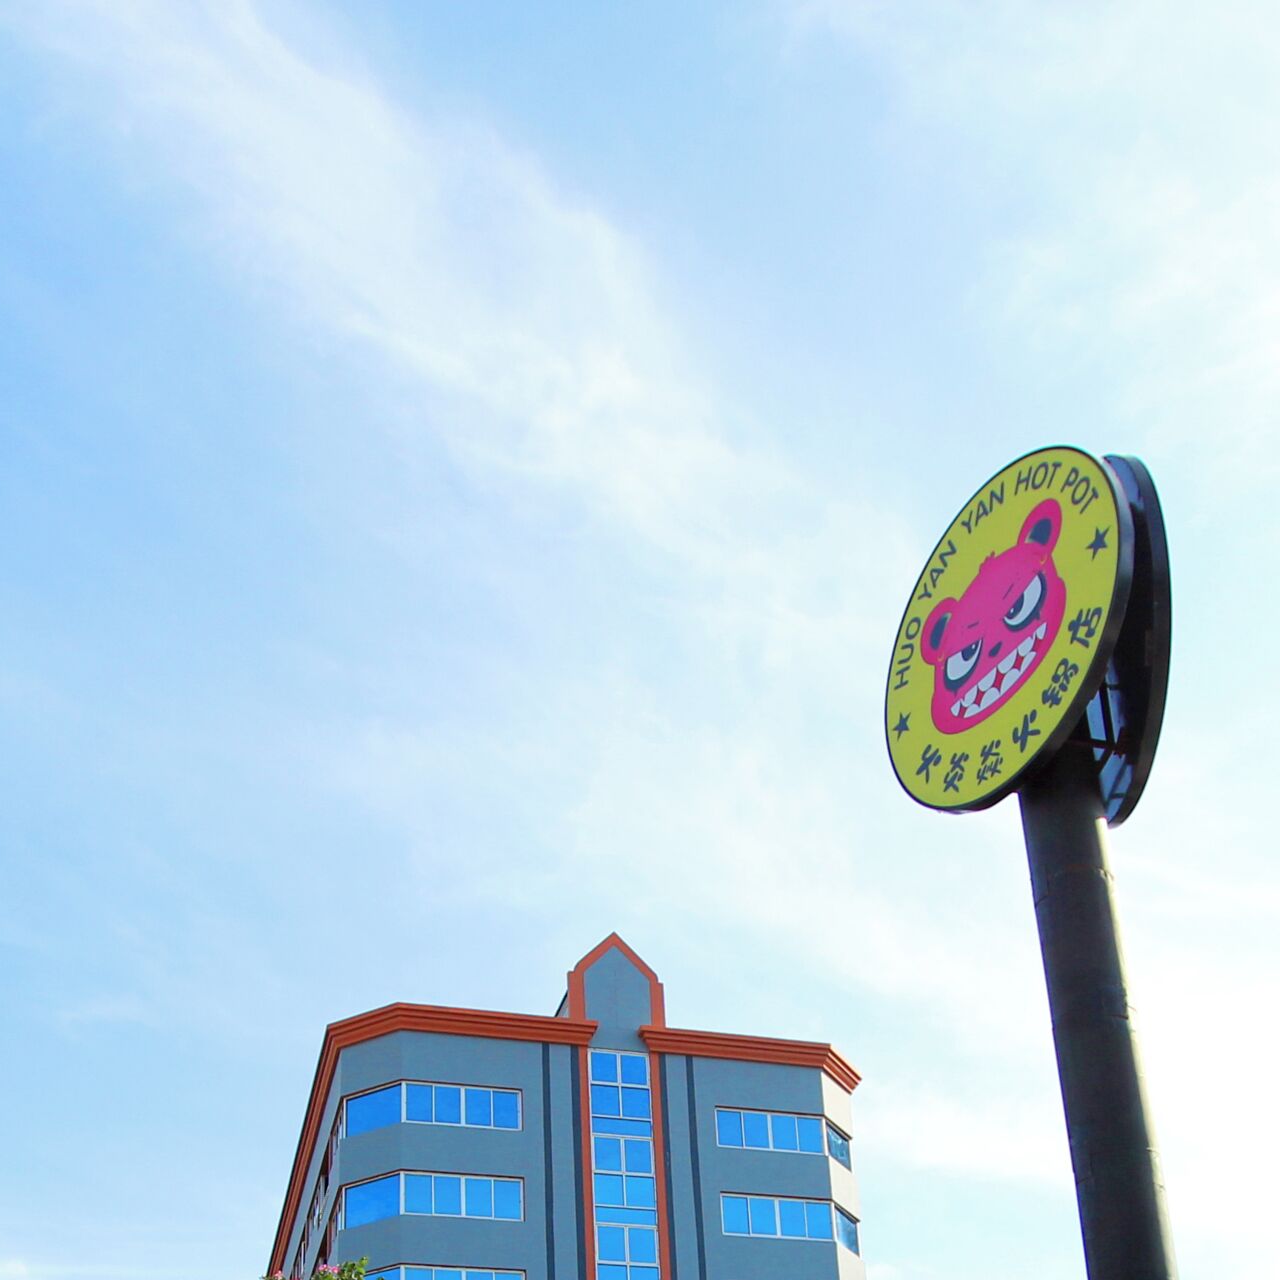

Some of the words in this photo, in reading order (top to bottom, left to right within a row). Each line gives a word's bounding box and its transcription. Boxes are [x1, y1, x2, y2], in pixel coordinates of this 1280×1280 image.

[893, 616, 922, 691] HUO
[918, 539, 958, 602] YAN
[961, 481, 1006, 535] YAN
[1014, 461, 1063, 497] HOT
[1061, 467, 1101, 515] POT
